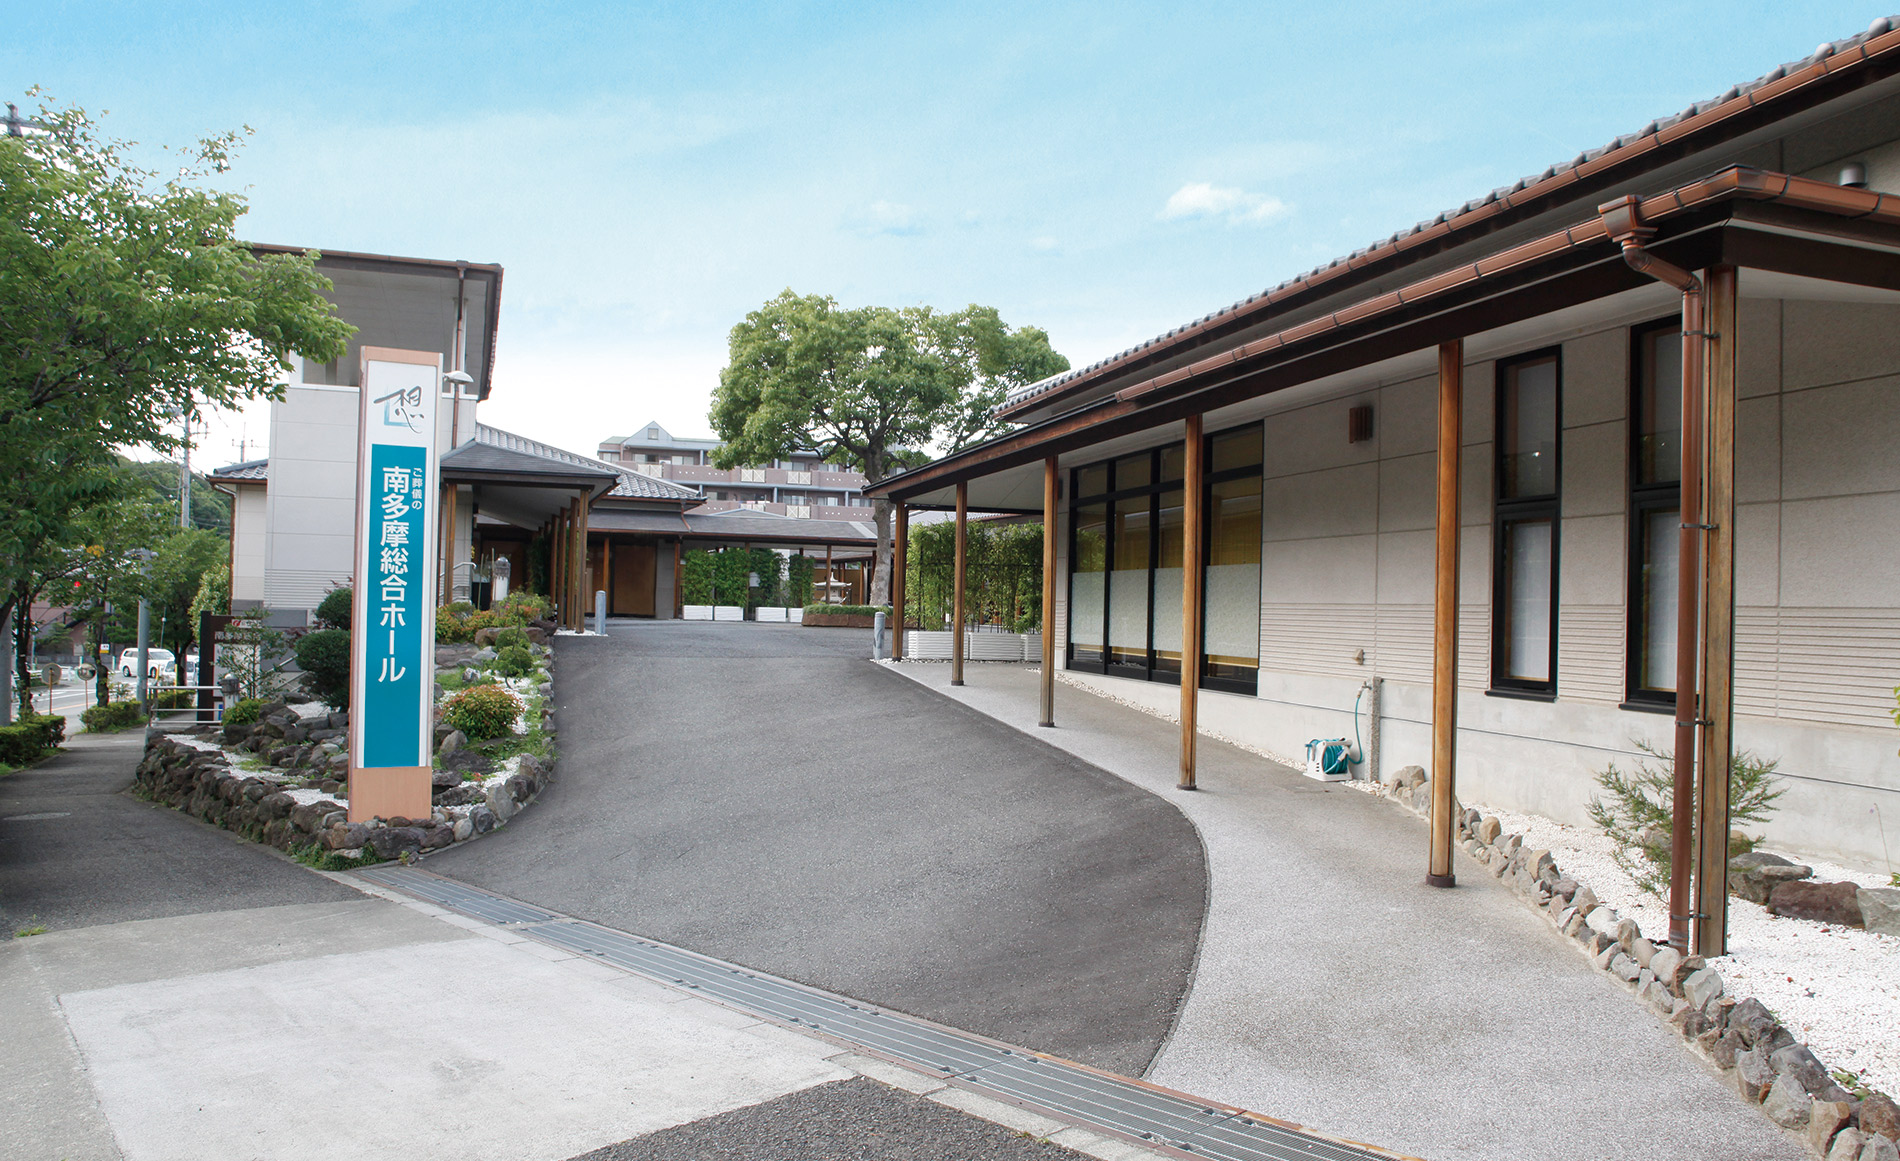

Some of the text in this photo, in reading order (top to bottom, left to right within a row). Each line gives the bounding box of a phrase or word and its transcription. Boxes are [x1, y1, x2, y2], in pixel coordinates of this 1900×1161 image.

[411, 467, 423, 510] ご葬儀の
[378, 466, 411, 683] 南多摩総合ホール
